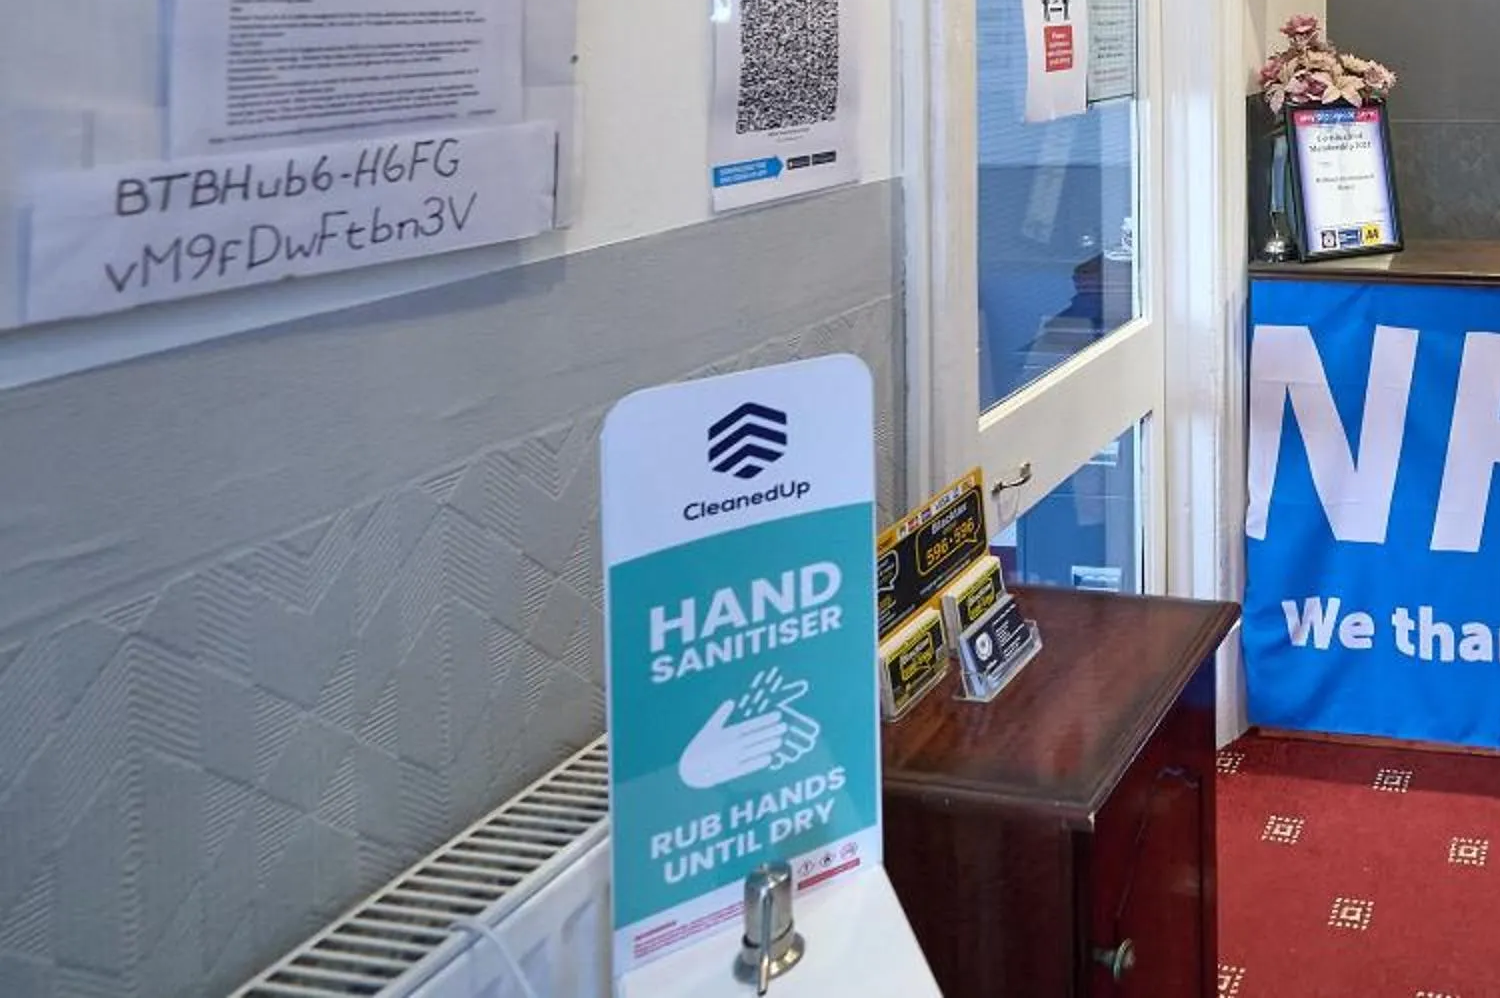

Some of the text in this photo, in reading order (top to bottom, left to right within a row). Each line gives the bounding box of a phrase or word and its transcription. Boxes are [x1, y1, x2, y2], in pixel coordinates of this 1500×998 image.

[683, 480, 811, 521] CleanedUp
[650, 561, 843, 653] HAND
[651, 604, 843, 683] SANITISER
[1281, 597, 1375, 651] We
[651, 766, 847, 859] RUB HANDS
[664, 798, 835, 883] UNTIL DRY
